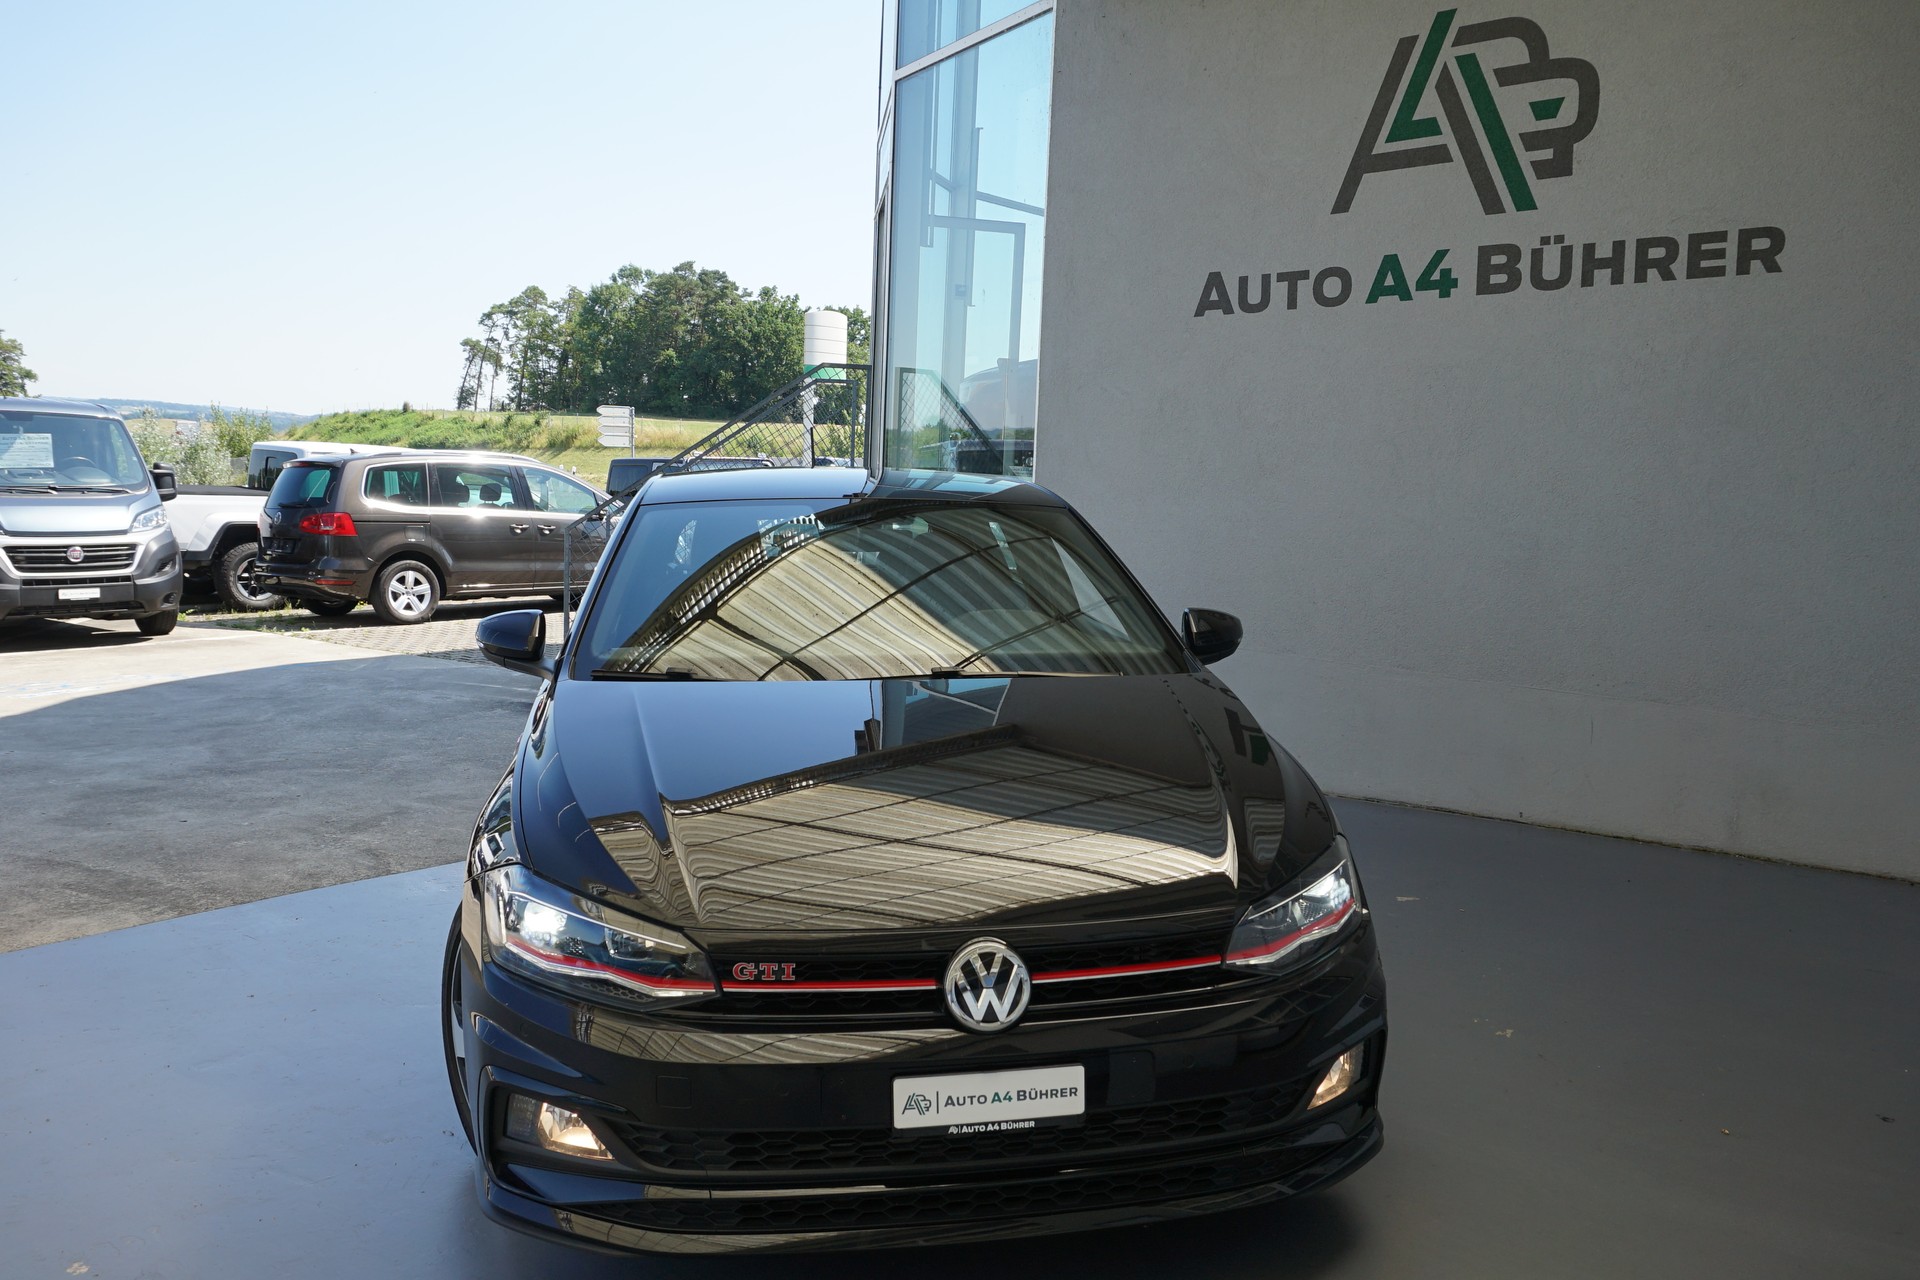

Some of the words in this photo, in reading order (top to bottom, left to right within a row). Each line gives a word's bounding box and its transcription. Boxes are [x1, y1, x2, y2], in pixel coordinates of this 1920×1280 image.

[1193, 266, 1353, 318] AUTO
[1364, 248, 1459, 305] A4
[1475, 226, 1787, 296] BÜHRER
[732, 961, 796, 981] GTI
[943, 1094, 988, 1108] AUTO
[990, 1091, 1013, 1104] A4
[1016, 1086, 1079, 1102] BÜHRER
[961, 1124, 986, 1133] AUTO
[986, 1122, 1000, 1132] A4
[1000, 1120, 1036, 1131] BÜHRER
